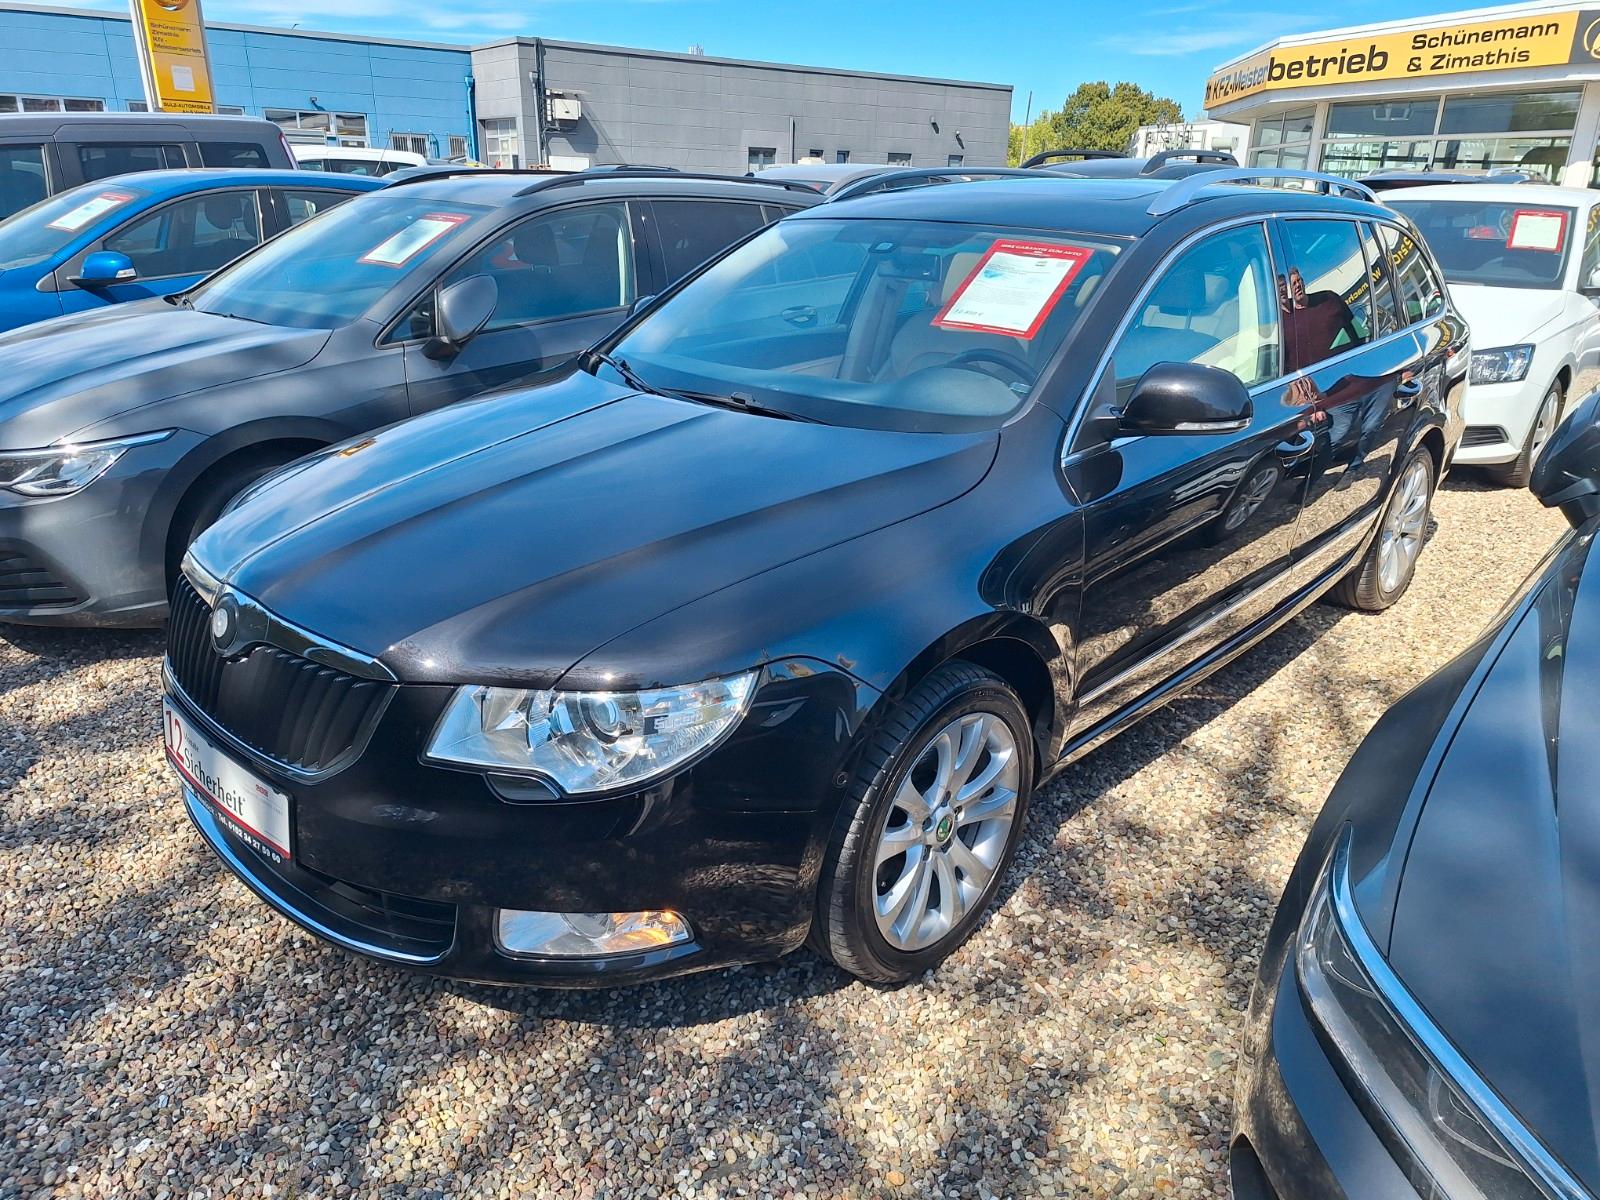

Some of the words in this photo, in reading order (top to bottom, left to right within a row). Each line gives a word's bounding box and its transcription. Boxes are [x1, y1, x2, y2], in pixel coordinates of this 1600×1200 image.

[1411, 22, 1560, 50] Schünemann
[1406, 56, 1422, 72] &
[1430, 47, 1530, 70] Zimathis
[166, 710, 185, 764] 12
[184, 747, 244, 816] Sicherheit
